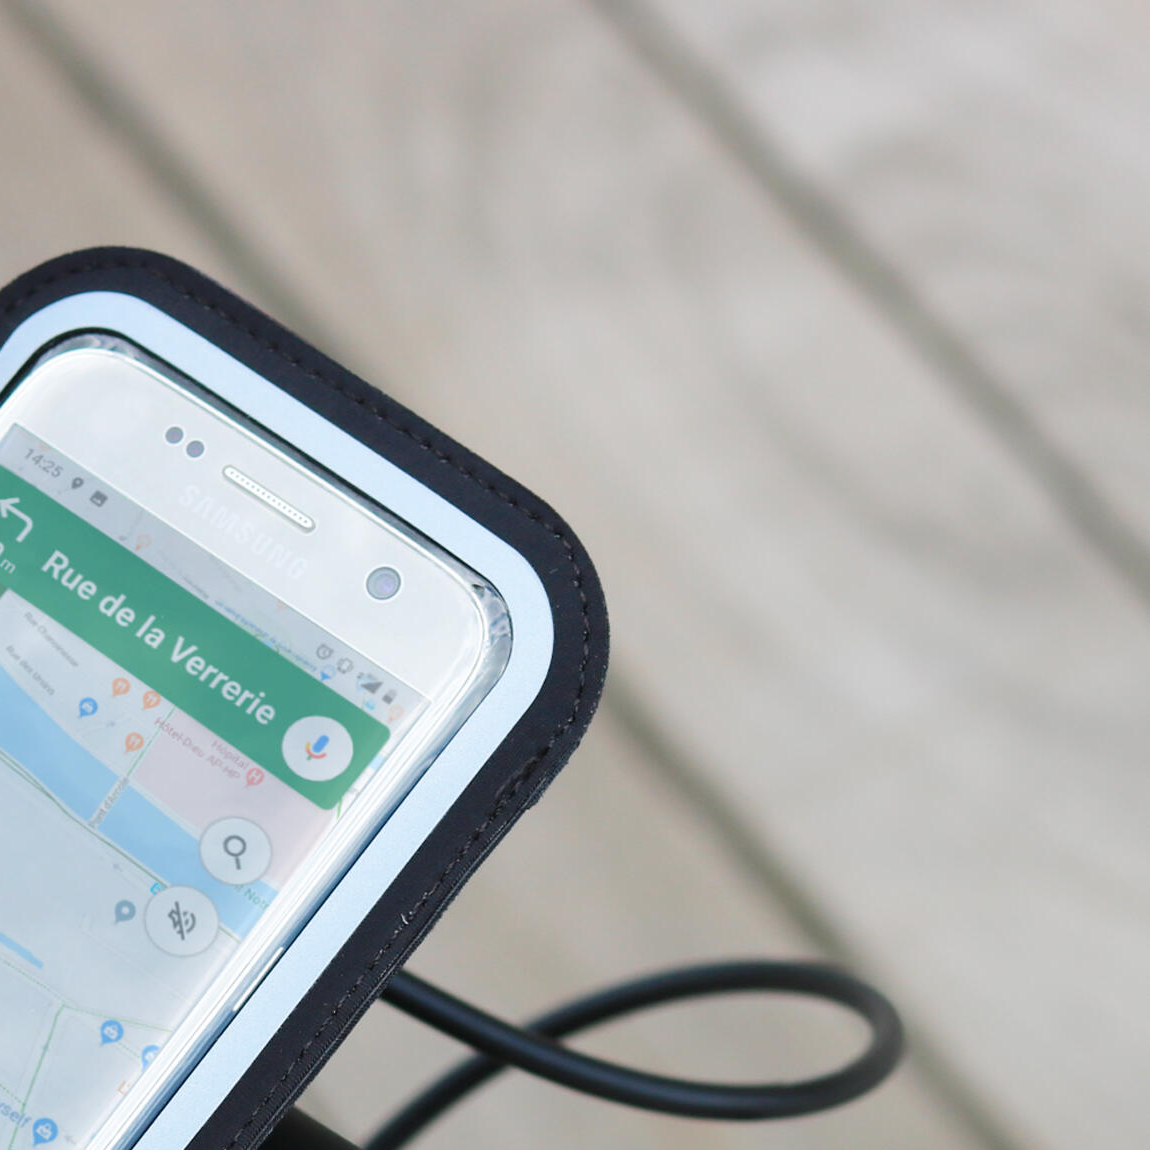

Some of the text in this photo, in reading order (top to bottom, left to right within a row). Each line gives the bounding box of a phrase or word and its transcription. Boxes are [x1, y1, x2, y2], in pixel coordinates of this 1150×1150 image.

[25, 448, 63, 478] 14:25
[179, 484, 308, 580] SAMSUNG
[0, 558, 16, 574] m
[24, 612, 38, 626] Rue
[41, 550, 98, 600] Rue
[98, 594, 135, 627] de
[135, 615, 166, 649] la
[170, 636, 276, 725] Verrerie
[6, 645, 20, 661] Rue
